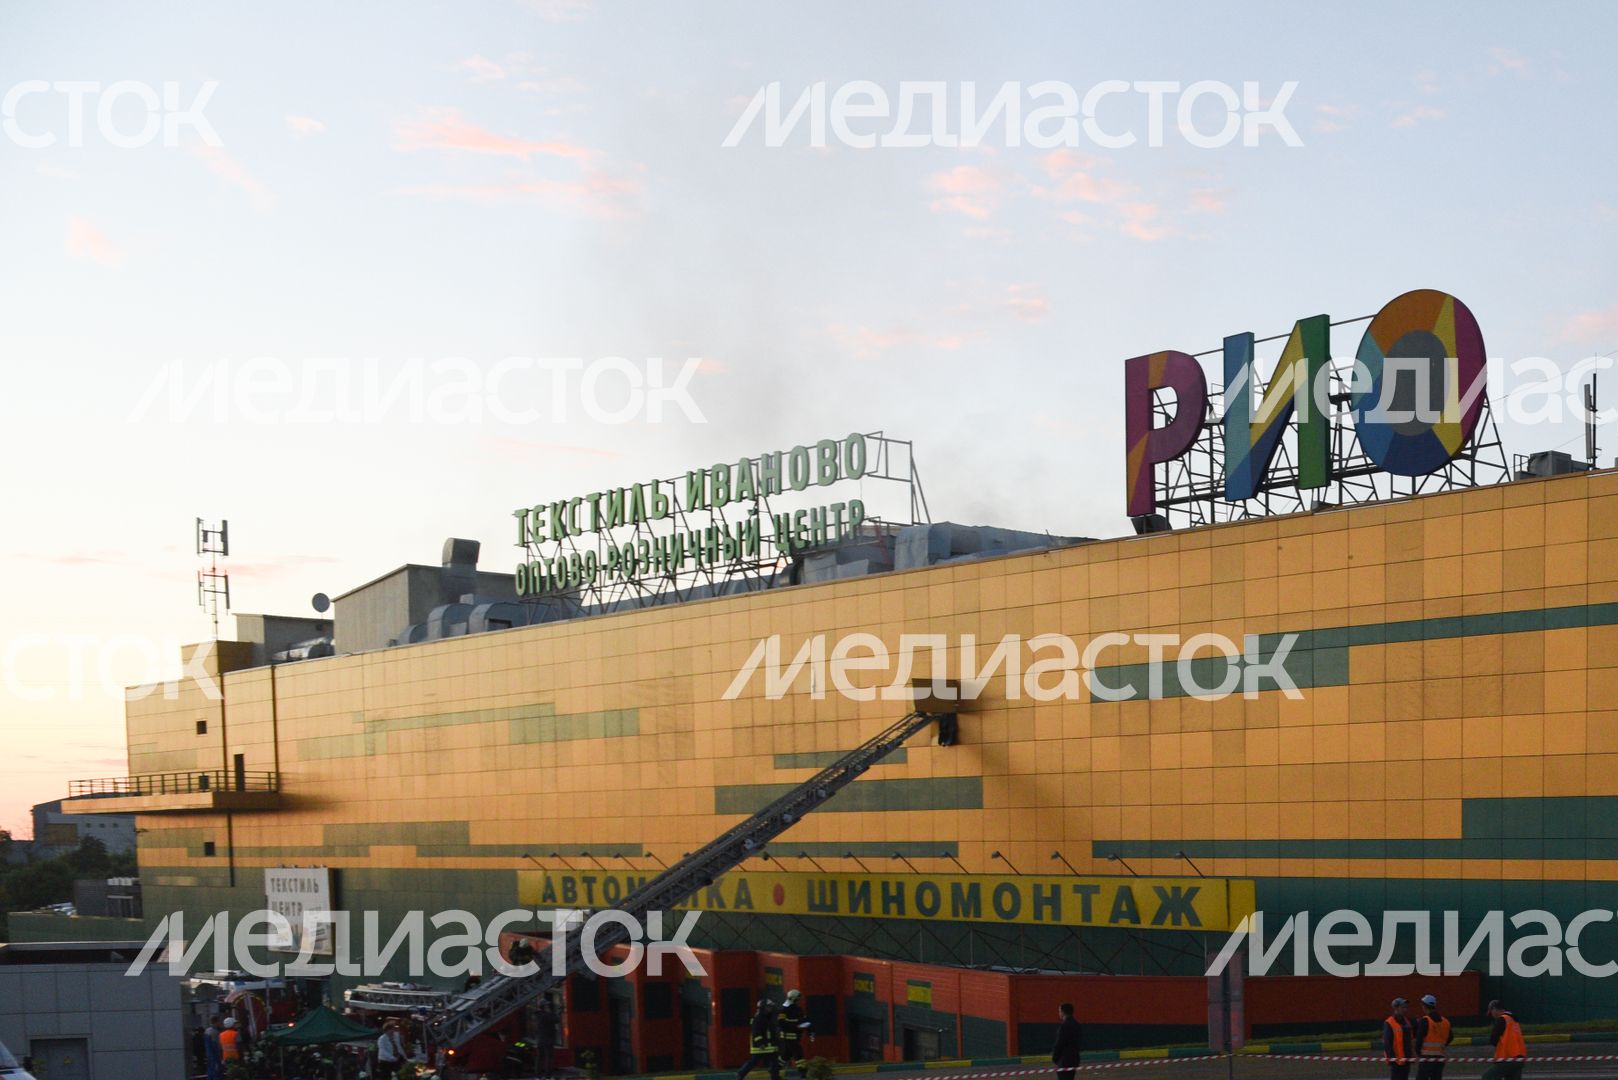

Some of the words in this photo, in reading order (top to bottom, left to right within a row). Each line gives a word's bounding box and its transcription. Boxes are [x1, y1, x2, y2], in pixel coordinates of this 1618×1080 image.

[1125, 289, 1487, 517] РИО
[512, 478, 669, 547] ТЕКСТИЛЬ
[686, 432, 867, 513] ИВАНОВО
[774, 499, 865, 557] ЦЕНТР
[270, 878, 319, 894] ТЕКСТИЛЬ
[271, 901, 303, 917] ЦЕНТР
[806, 878, 1203, 927] ШИНОМОНТАЖ
